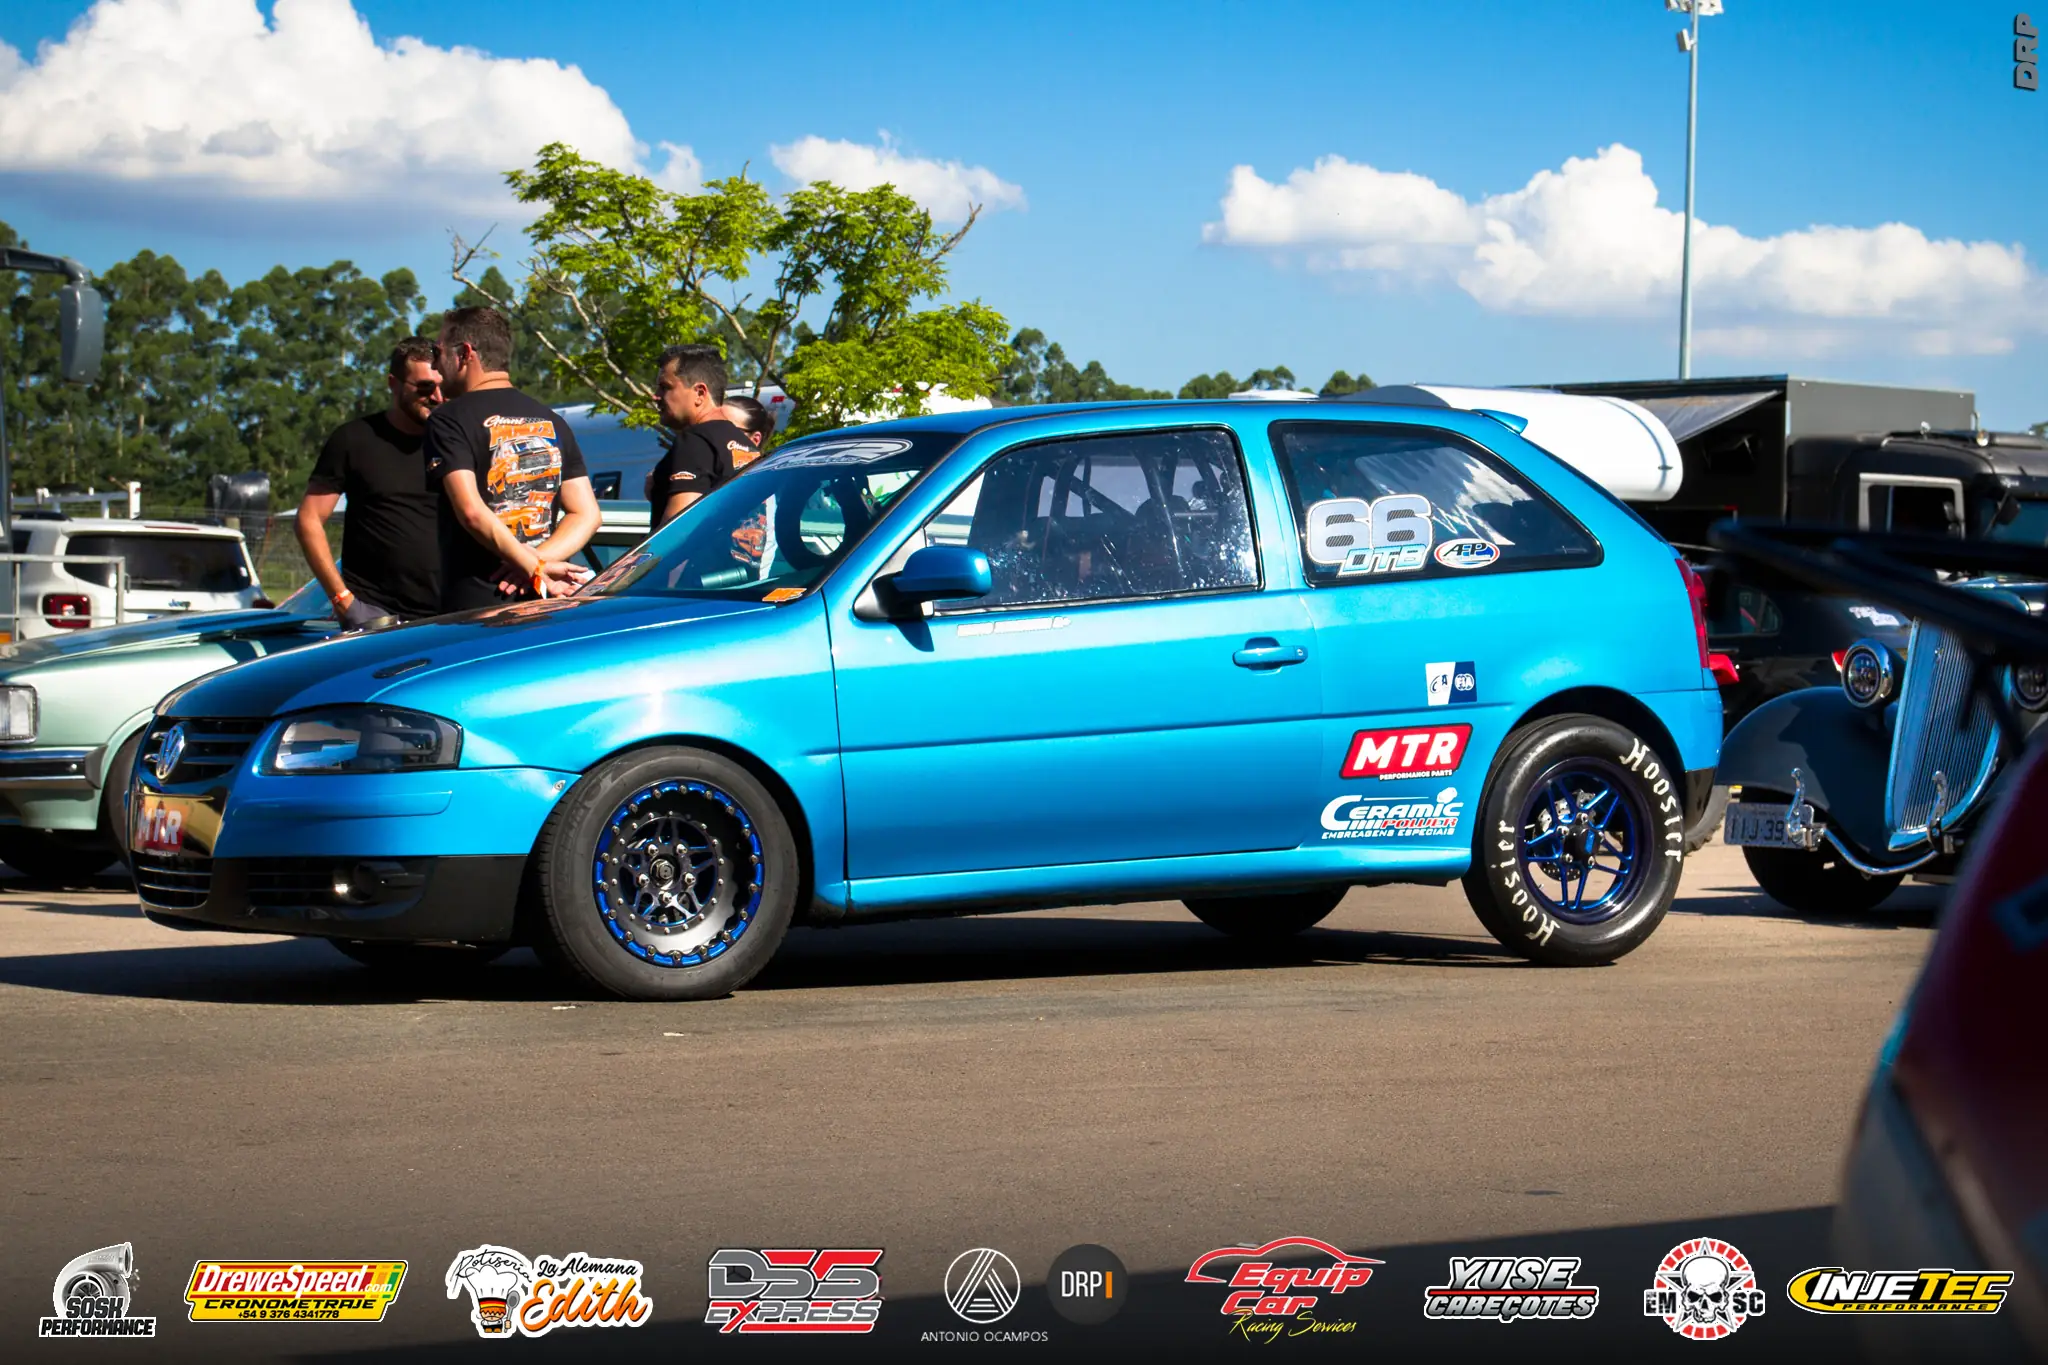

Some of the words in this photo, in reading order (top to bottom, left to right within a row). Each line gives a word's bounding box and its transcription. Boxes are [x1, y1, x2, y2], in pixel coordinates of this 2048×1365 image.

[1308, 494, 1433, 565] 66
[1353, 732, 1458, 770] MTR
[1379, 772, 1430, 781] PERFORMANCE
[1431, 769, 1453, 777] PARTS
[1619, 738, 1683, 862] Hoosier
[137, 808, 182, 845] MTR
[1322, 830, 1394, 839] EMBREAGENS
[1398, 828, 1455, 837] ESPECIAIS
[1381, 818, 1458, 829] POWER
[1498, 820, 1560, 946] Hoosier
